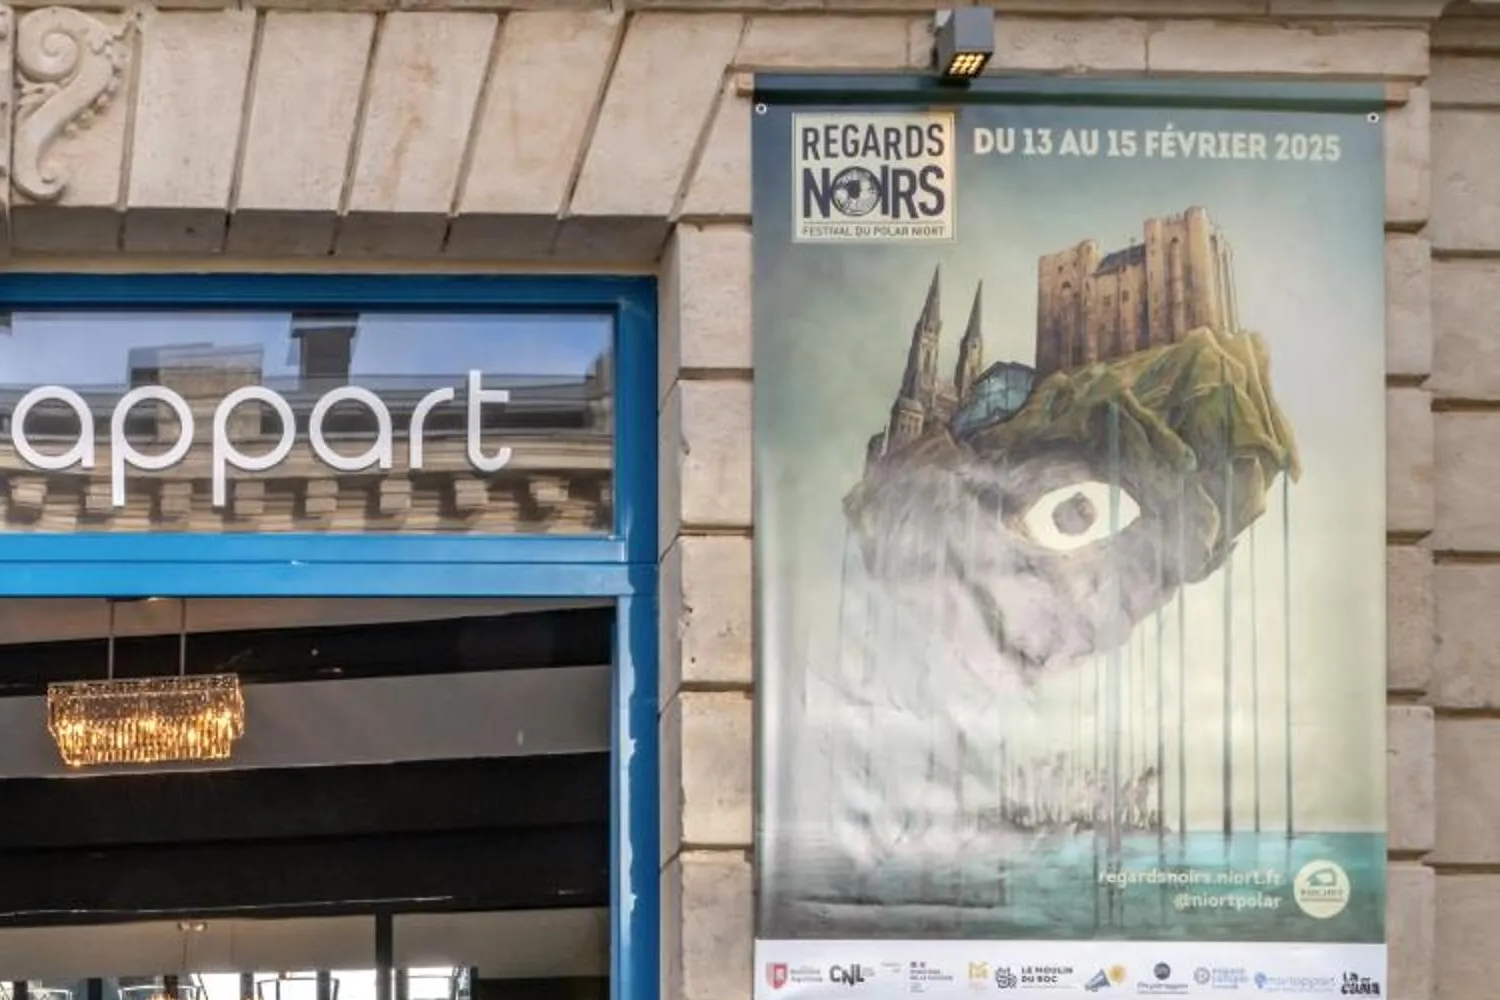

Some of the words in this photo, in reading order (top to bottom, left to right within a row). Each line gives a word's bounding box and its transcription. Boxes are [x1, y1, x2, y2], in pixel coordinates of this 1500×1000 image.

[802, 124, 946, 160] REGARDS
[974, 127, 1016, 154] DU
[1024, 128, 1054, 154] 13
[1060, 128, 1099, 156] AU
[1106, 129, 1138, 156] 15
[1145, 122, 1266, 160] FÉVRIER
[1274, 134, 1342, 162] 2025
[803, 165, 946, 219] NOIRS
[802, 226, 851, 237] FESTIVAL
[856, 226, 871, 236] DU
[874, 226, 909, 236] POLAR
[912, 226, 944, 236] NIORT
[11, 369, 511, 507] appart
[1099, 868, 1282, 889] regardsnoirs.niort.fr
[1173, 893, 1282, 912] @niortpolar
